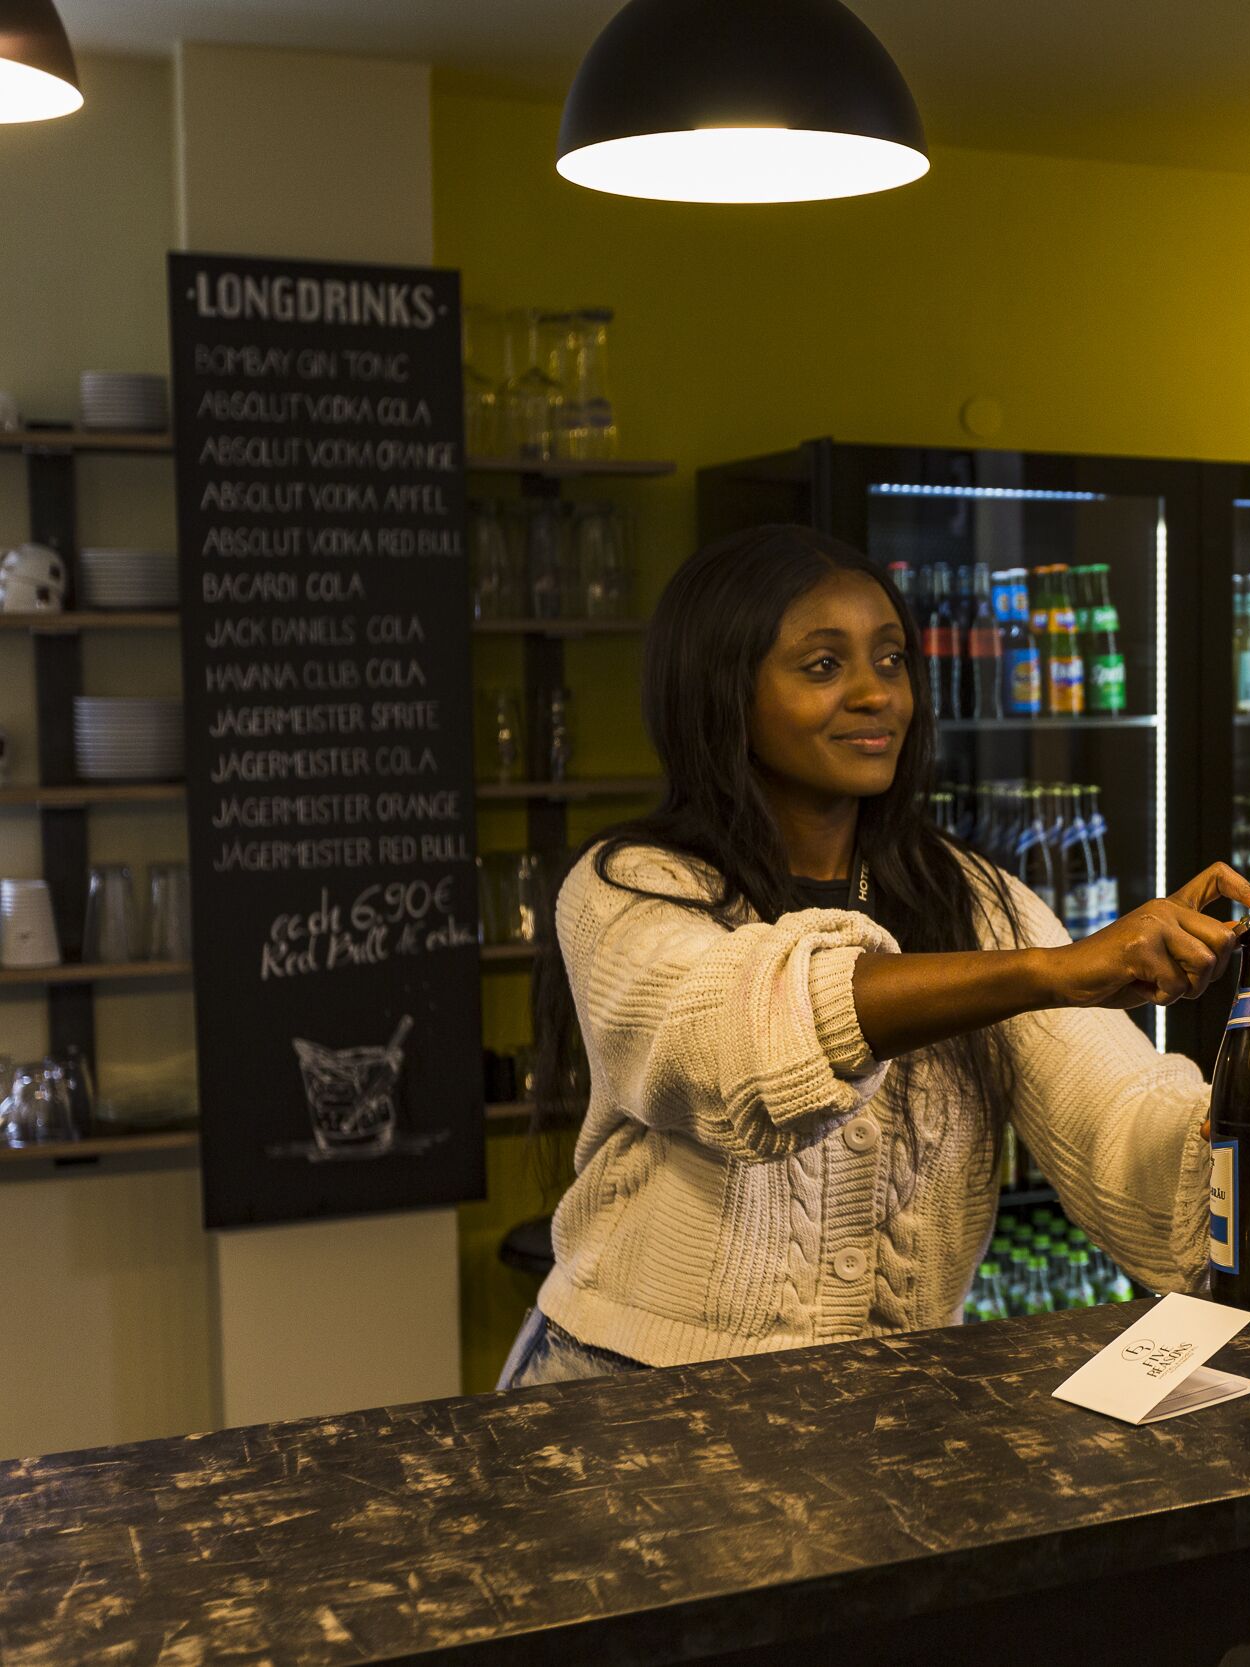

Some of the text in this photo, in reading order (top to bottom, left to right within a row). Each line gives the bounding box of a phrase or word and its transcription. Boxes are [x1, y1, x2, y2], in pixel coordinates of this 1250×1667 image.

[196, 271, 436, 330] LONGDRINKS
[194, 343, 409, 384] BOMBAY GIN TONIC
[196, 390, 432, 428] ABSOLUT VODKA COLA
[199, 435, 459, 472] ABSOLUT VODKA ORANGE
[200, 480, 449, 515] ABSOLUT VODKA APFEL
[201, 526, 463, 559] ABSOLUT VODKA RED BULL
[202, 571, 366, 603] BACARDI COLA
[205, 613, 426, 649] JACK DANIELS COLA
[205, 657, 427, 692] HAVANA CLUB COLA
[370, 700, 441, 732] SPRITE
[375, 745, 439, 776] COLA
[375, 789, 461, 822] ORANGE
[379, 835, 417, 864] RED
[420, 832, 470, 862] BULL
[260, 935, 319, 981] Red
[326, 924, 391, 971] Bull
[1142, 1344, 1171, 1368] FIVE
[1146, 1342, 1193, 1378] REASONS
